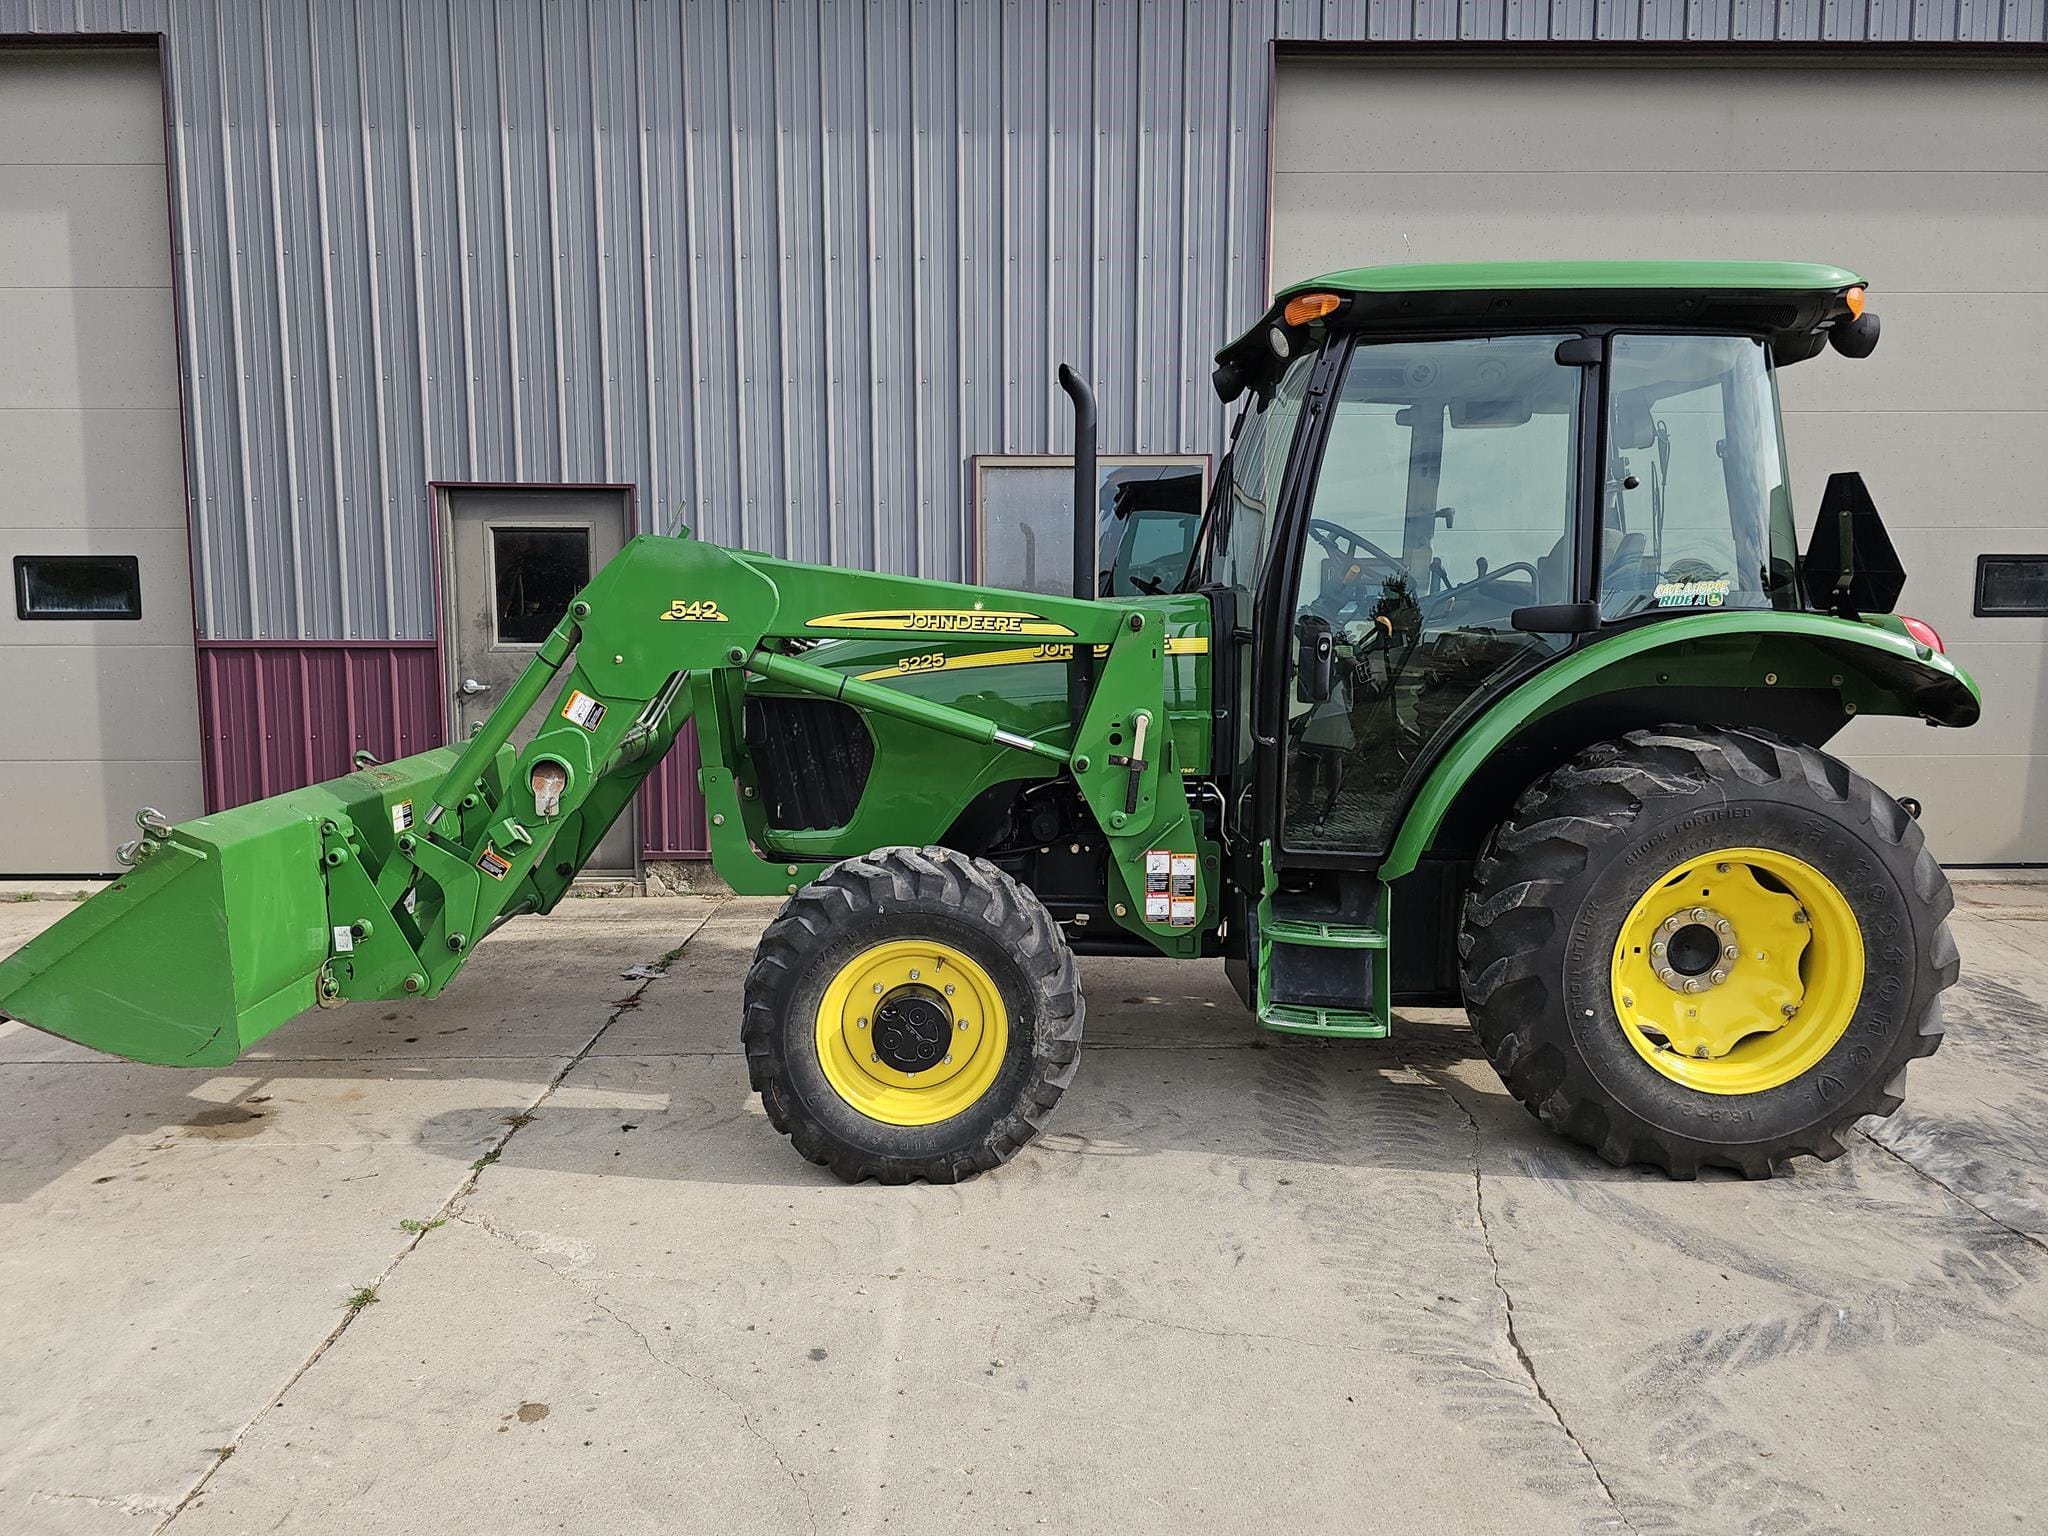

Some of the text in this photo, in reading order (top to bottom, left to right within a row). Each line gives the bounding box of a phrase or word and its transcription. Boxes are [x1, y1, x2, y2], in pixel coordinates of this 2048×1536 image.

[671, 600, 718, 619] 542
[1660, 594, 1705, 606] RIDE A
[904, 612, 1022, 632] JOHN DEERE
[1033, 643, 1074, 658] JOH
[898, 652, 945, 672] 5225
[1624, 831, 1668, 866] SHOCK
[1674, 807, 1753, 834] FORTIFIED
[1571, 901, 1599, 962] UTILITY
